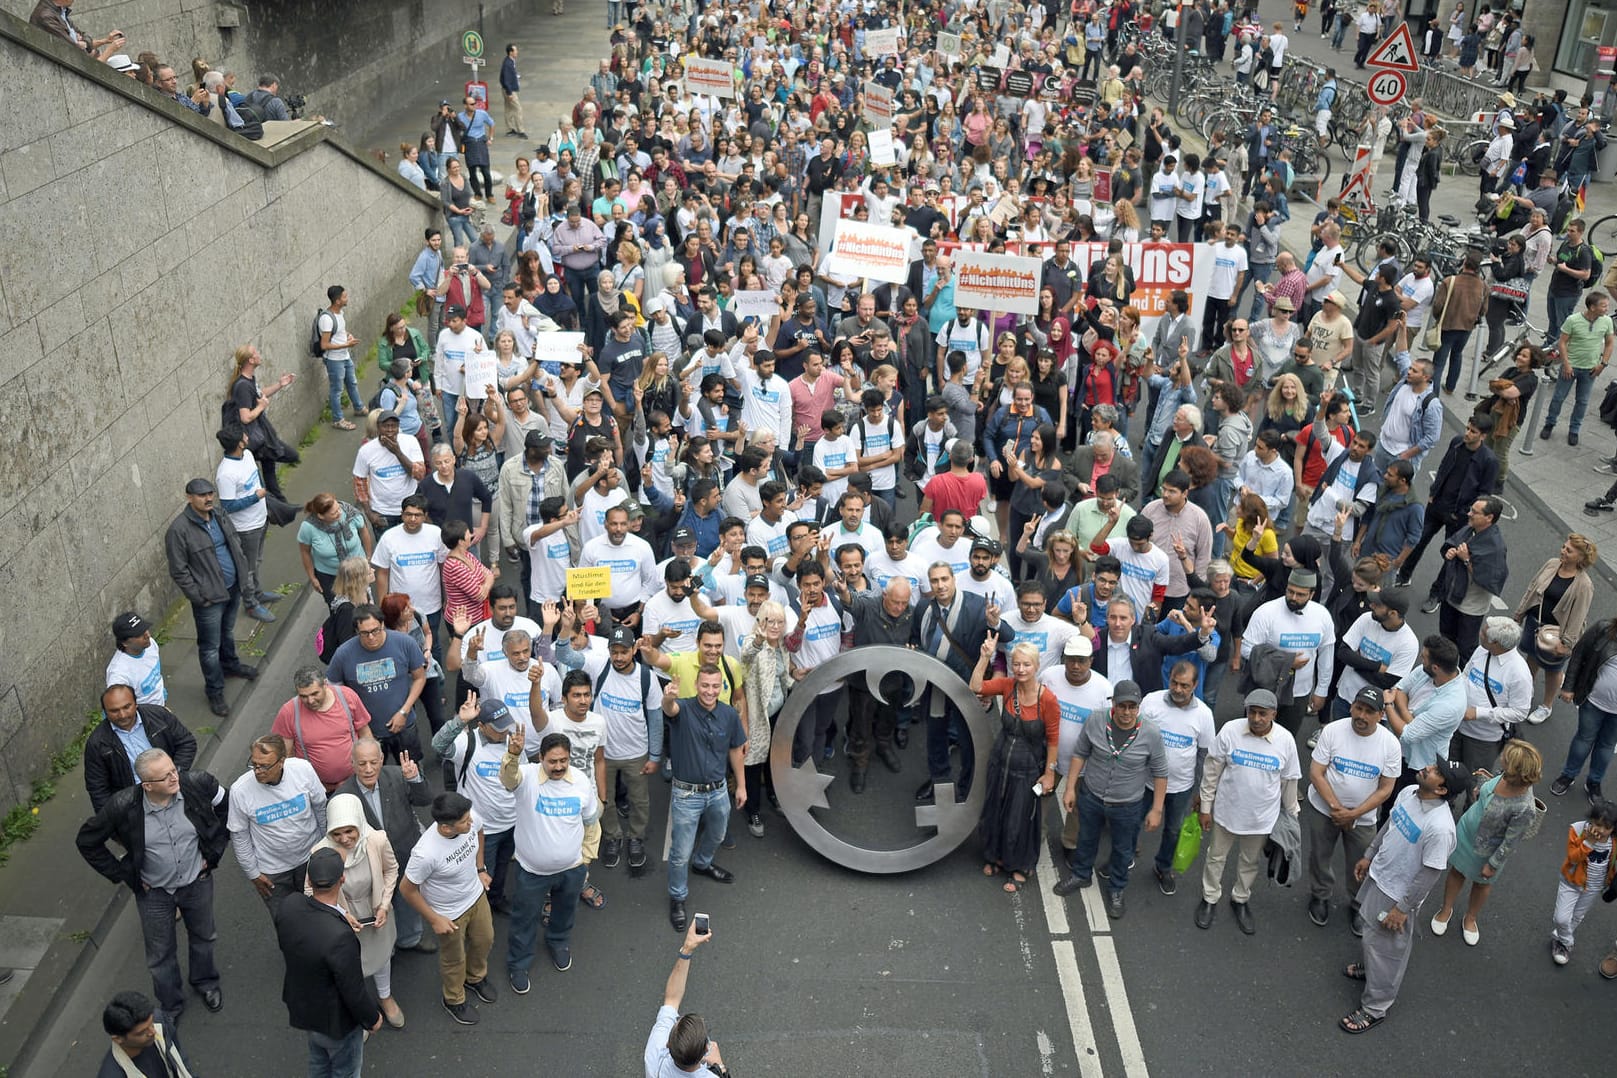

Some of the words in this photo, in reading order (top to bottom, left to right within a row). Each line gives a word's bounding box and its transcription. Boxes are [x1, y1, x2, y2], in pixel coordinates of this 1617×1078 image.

[1375, 79, 1398, 96] 40
[961, 273, 1035, 290] #NichtMitUns
[573, 572, 604, 580] Muslime
[595, 579, 606, 587] den
[368, 682, 389, 693] 2010
[1234, 750, 1265, 763] Muslime
[1264, 756, 1274, 764] für
[1334, 756, 1364, 769] Muslime
[1363, 763, 1374, 772] für
[1243, 760, 1277, 771] FRIEDEN
[1343, 766, 1377, 779] FRIEDEN
[266, 806, 299, 821] FRIEDEN
[446, 841, 469, 864] MUSLIME
[455, 844, 477, 866] FRIEDEN
